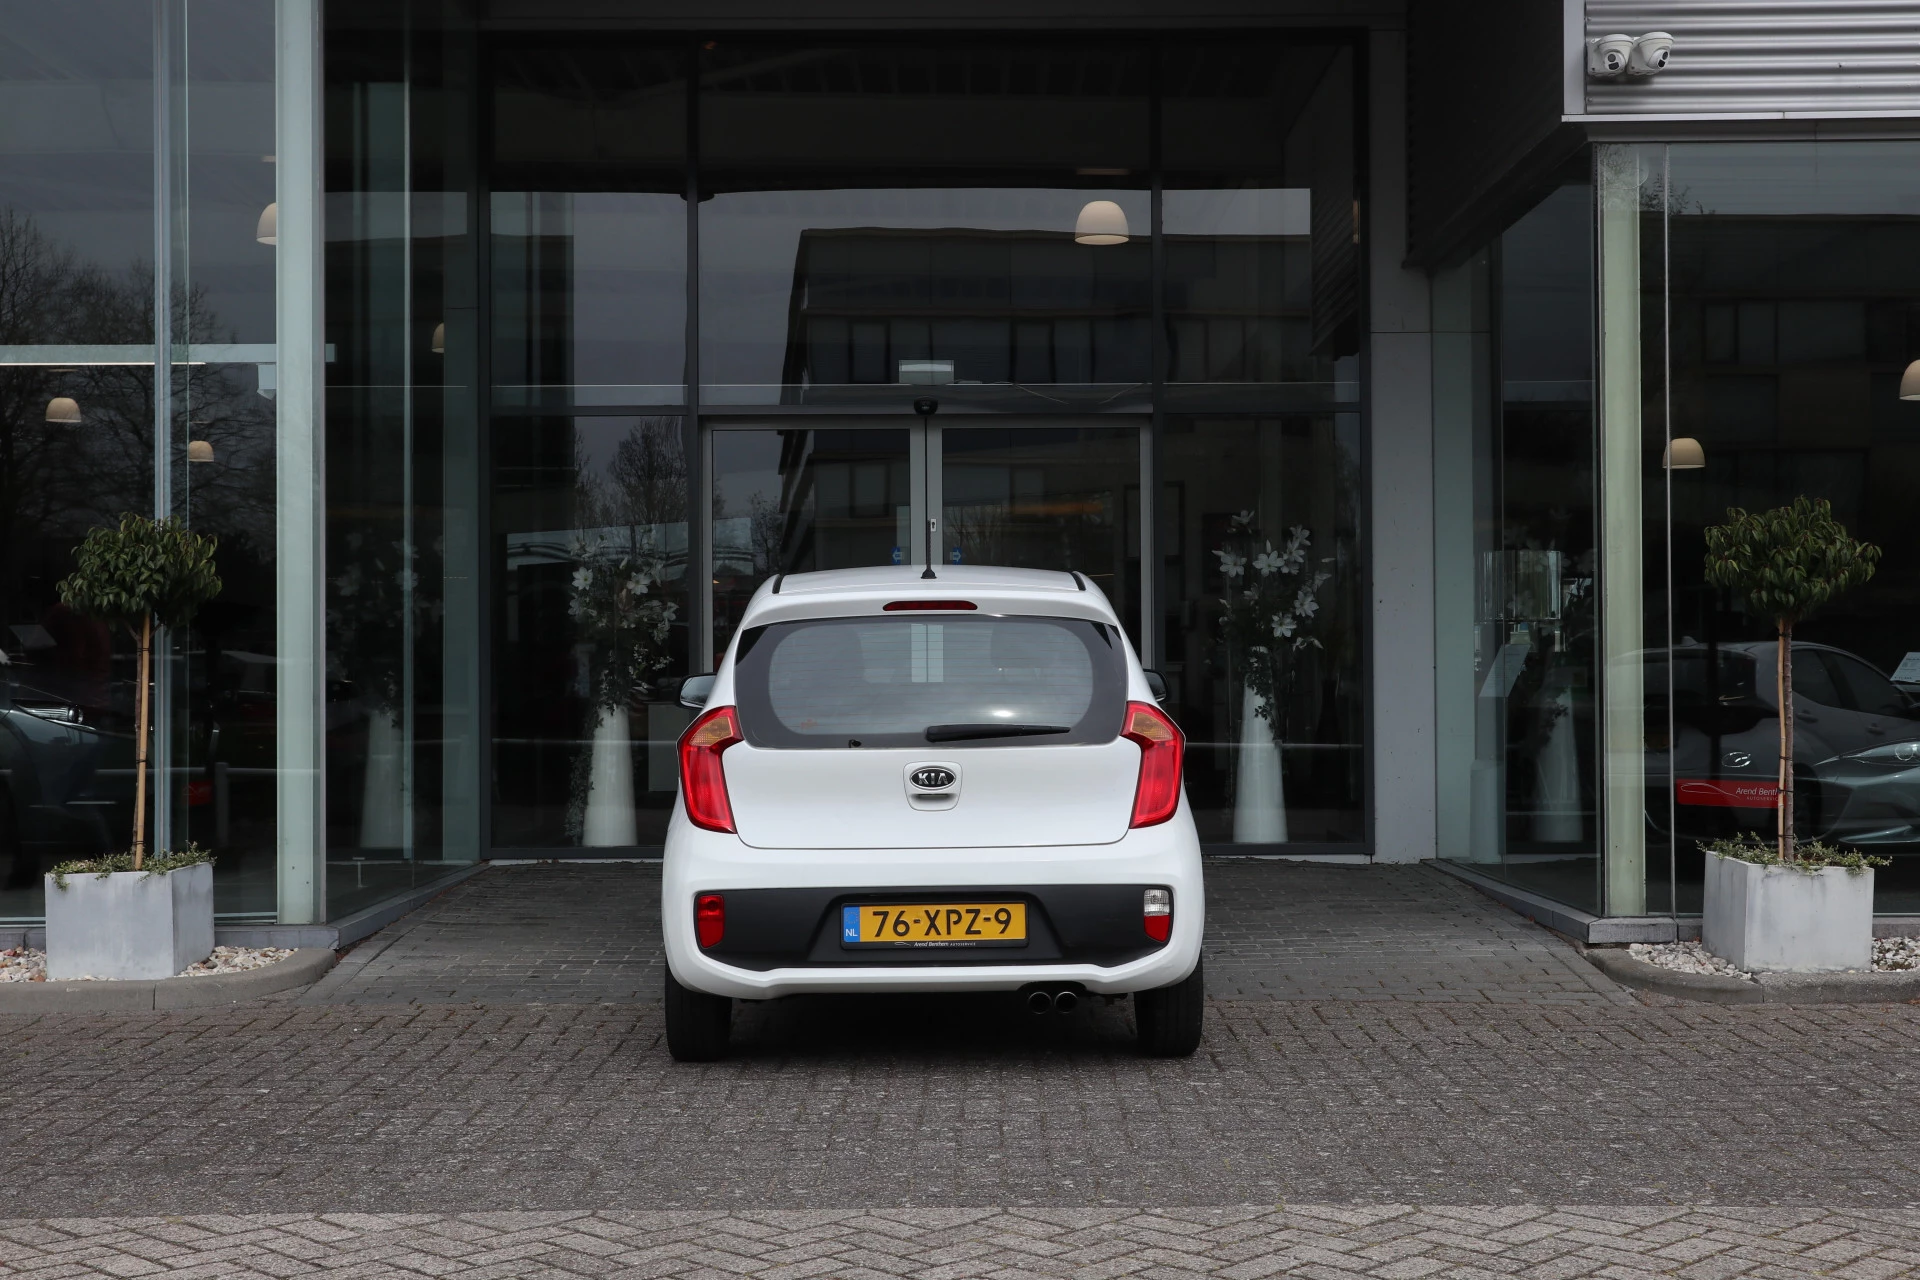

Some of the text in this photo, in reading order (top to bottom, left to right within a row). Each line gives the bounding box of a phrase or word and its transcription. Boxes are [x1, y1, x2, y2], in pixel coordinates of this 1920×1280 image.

[917, 772, 949, 785] KIA
[1736, 787, 1758, 795] Arend
[872, 907, 1012, 938] 76-XPZ-9
[845, 928, 859, 937] NL
